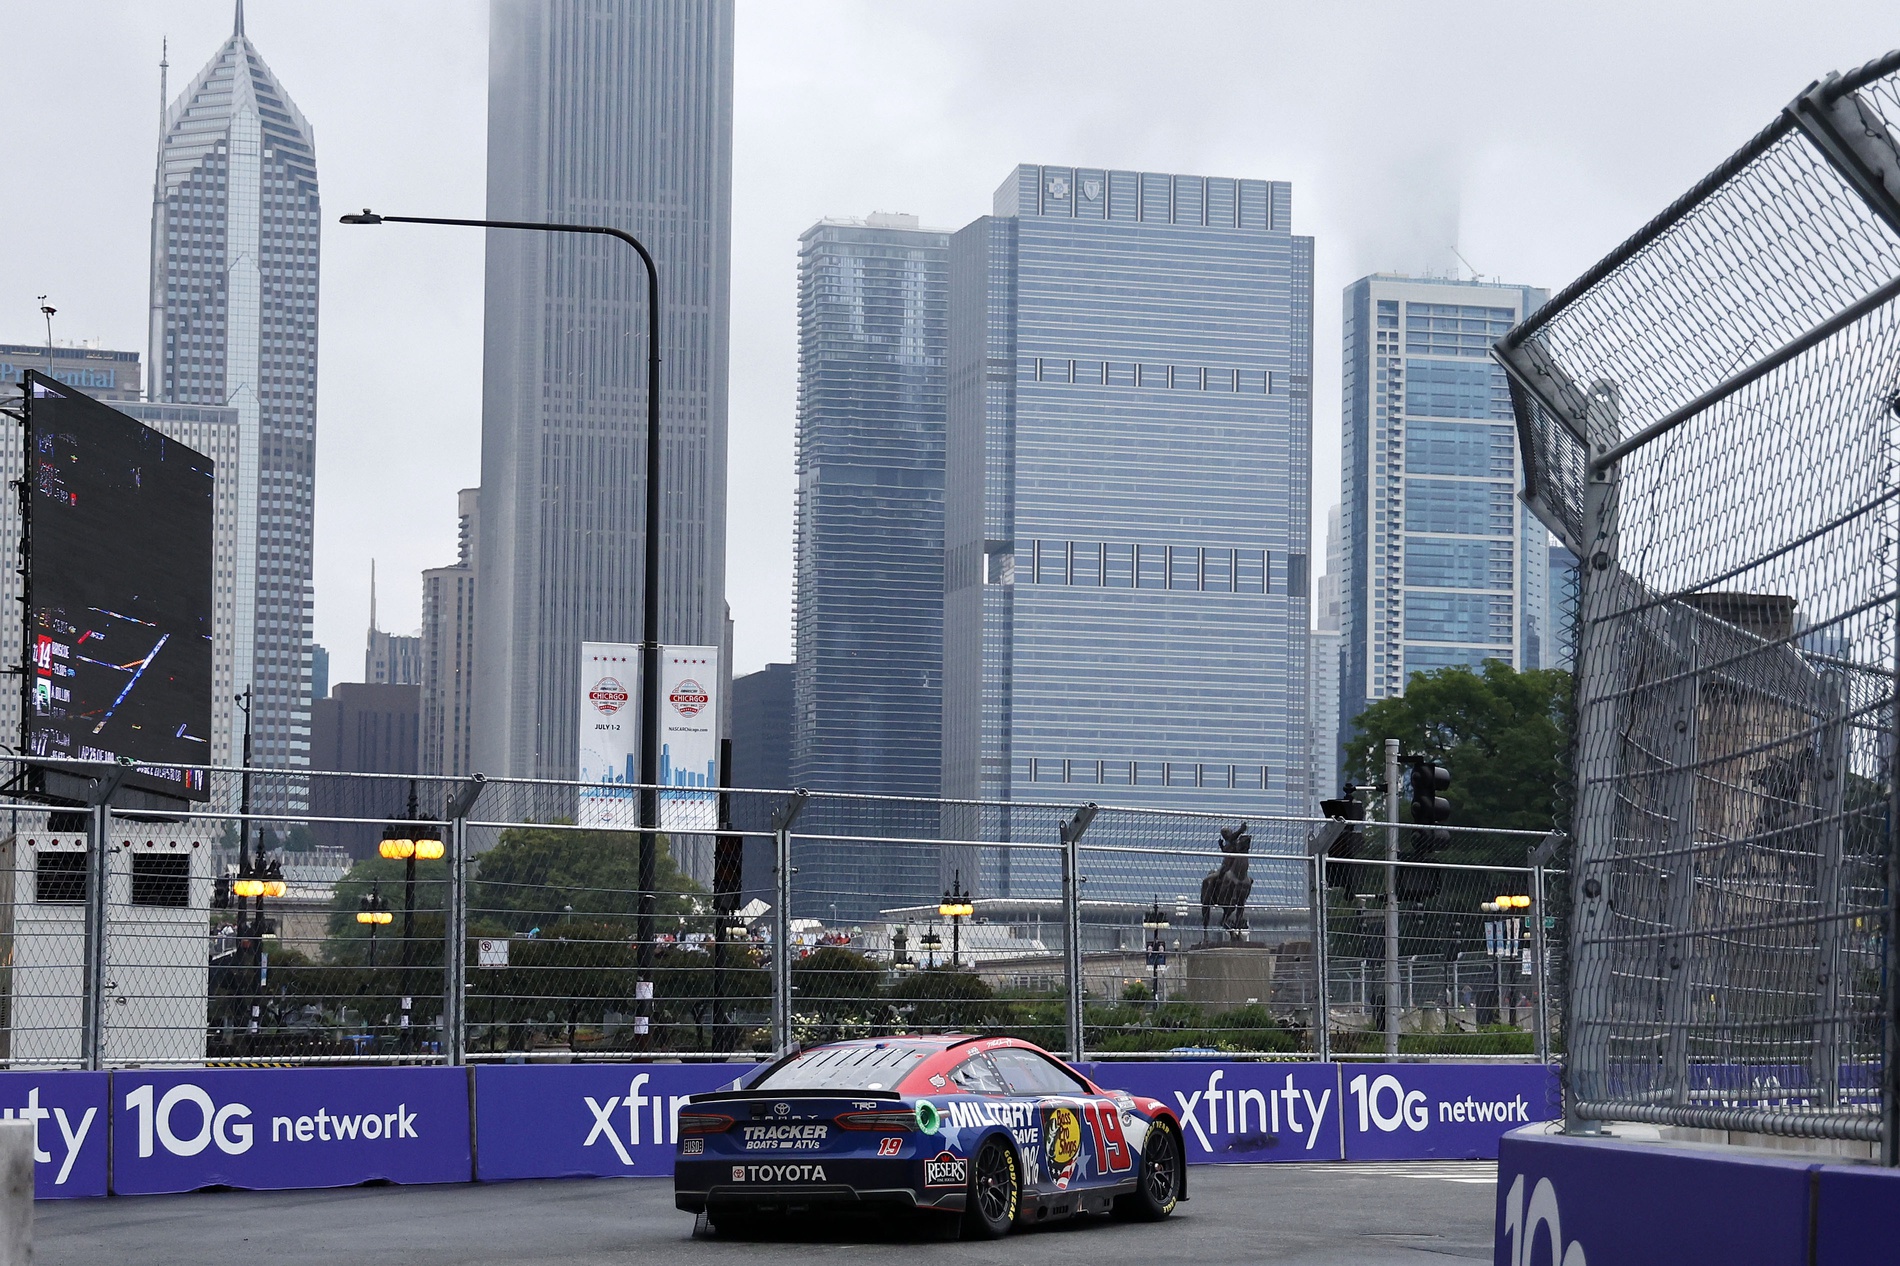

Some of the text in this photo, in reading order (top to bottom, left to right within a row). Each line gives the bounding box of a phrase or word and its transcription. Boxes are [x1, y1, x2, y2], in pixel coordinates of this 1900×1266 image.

[0, 363, 116, 388] Prdential
[38, 642, 52, 669] 14
[592, 692, 625, 700] CHICAGO
[1174, 1070, 1331, 1153] xfinity
[1350, 1074, 1530, 1133] 10G network
[126, 1084, 418, 1157] 10G network
[948, 1101, 1035, 1128] MILITARY
[1056, 1109, 1072, 1126] Bass
[3, 1086, 98, 1185] ty
[743, 1125, 828, 1140] TRACKER
[1012, 1127, 1039, 1145] SAVE
[1060, 1125, 1070, 1140] Pro
[1082, 1100, 1133, 1176] 19
[687, 1140, 700, 1153] USO
[746, 1140, 820, 1149] BOATS ATVs
[877, 1138, 903, 1156] 19
[1059, 1139, 1077, 1157] Shops
[747, 1165, 827, 1182] TOYOTA
